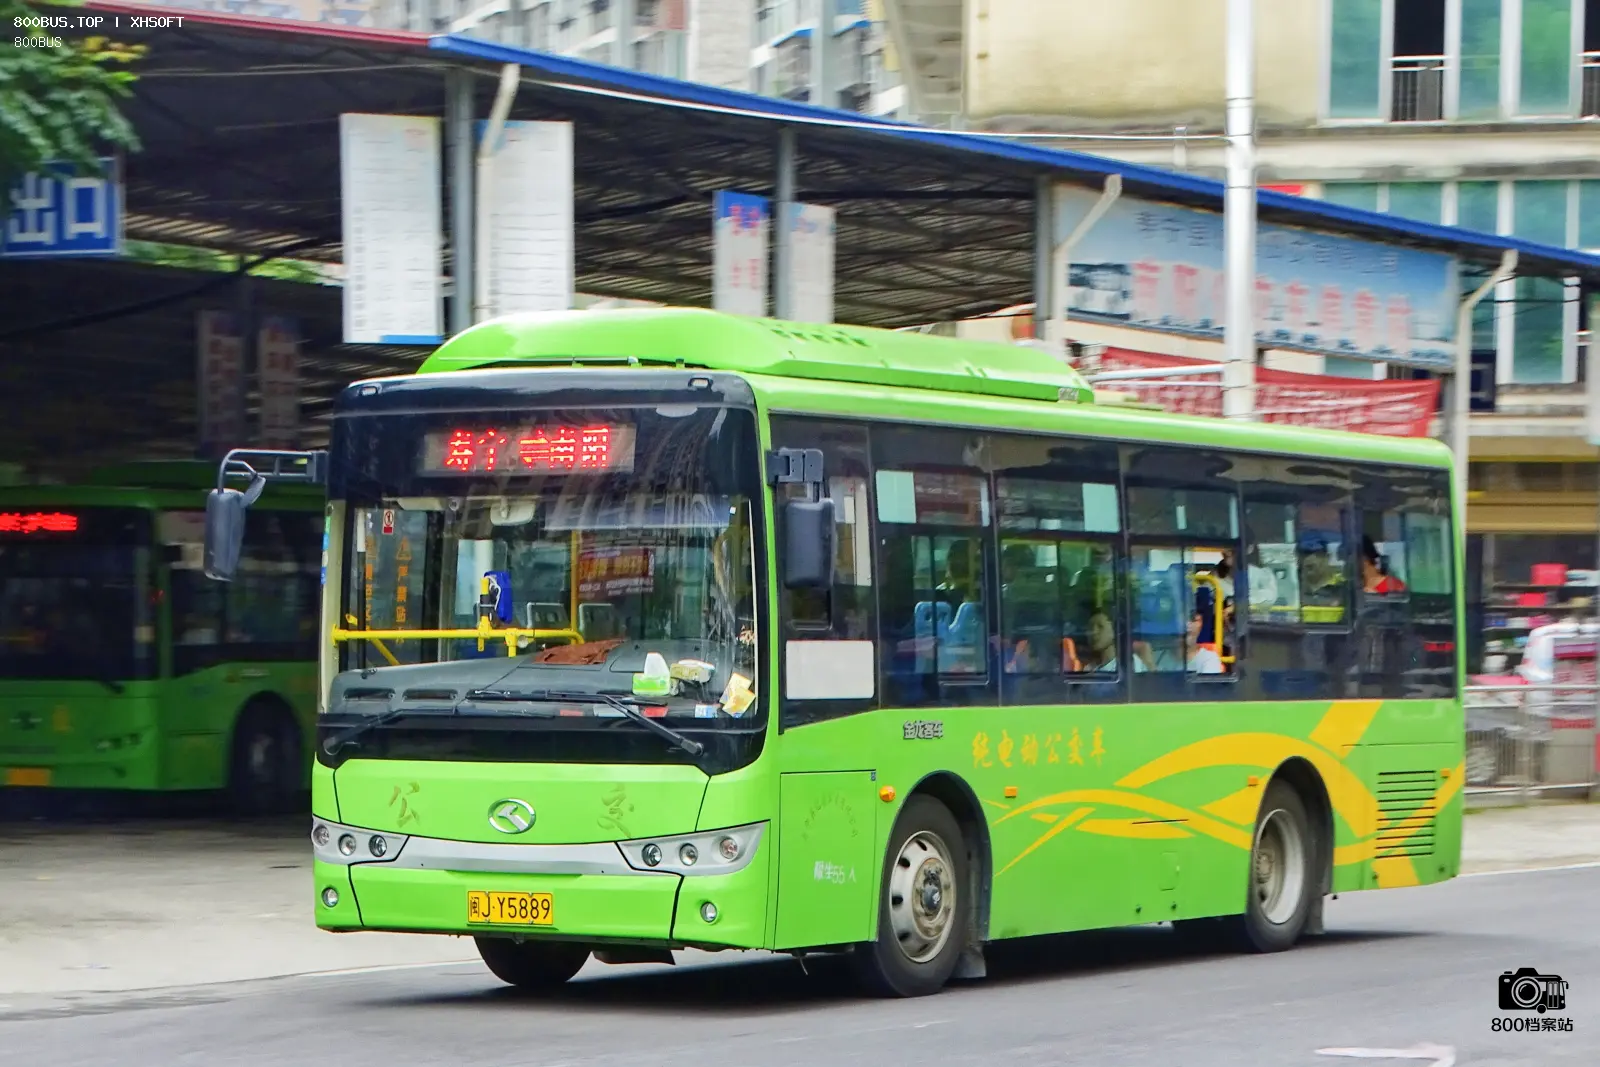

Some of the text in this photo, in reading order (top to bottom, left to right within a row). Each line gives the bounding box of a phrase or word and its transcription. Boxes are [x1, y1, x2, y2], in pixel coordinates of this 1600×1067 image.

[9, 171, 108, 246] 出口
[902, 719, 944, 740] 金龙客车
